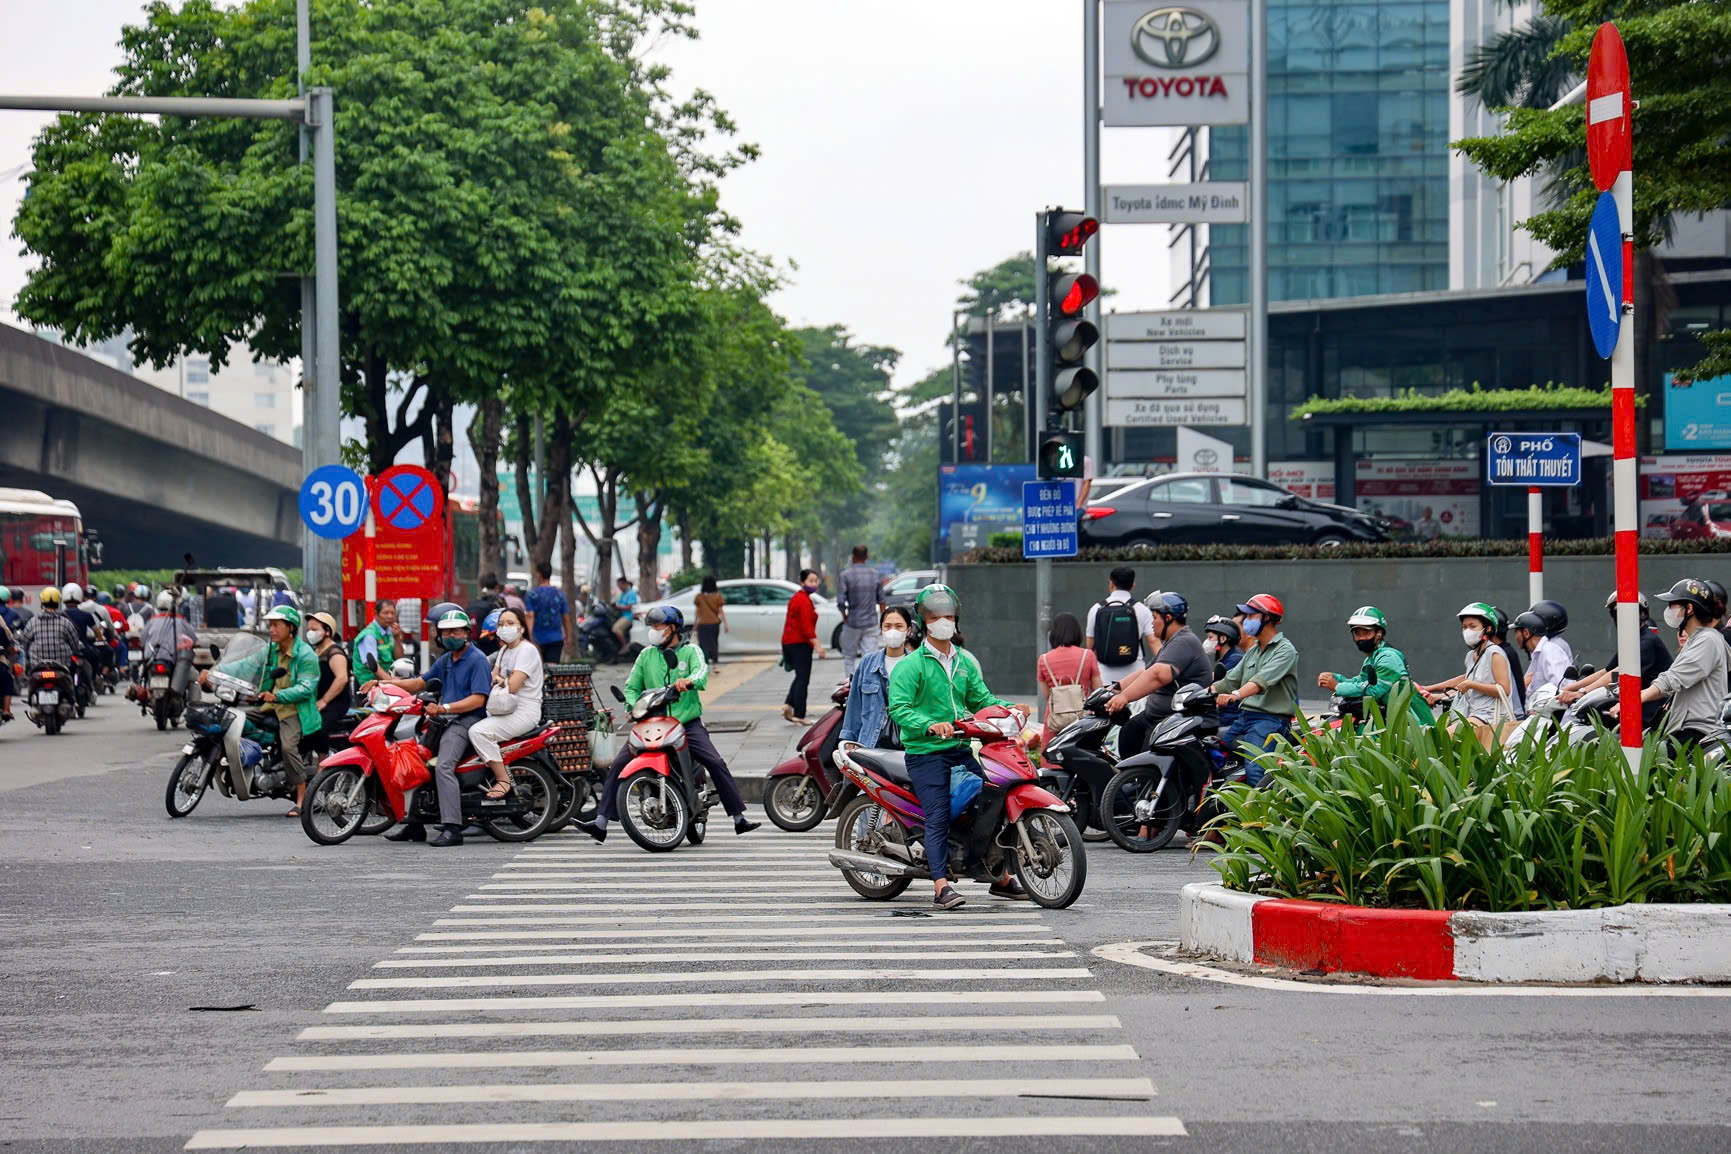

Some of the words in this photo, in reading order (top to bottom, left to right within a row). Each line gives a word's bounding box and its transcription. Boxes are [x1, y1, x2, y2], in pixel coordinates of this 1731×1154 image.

[1123, 76, 1228, 98] TOYOTA
[1111, 196, 1152, 213] Toyota
[1520, 437, 1554, 452] PHỐ
[1496, 455, 1514, 477] TÔN
[1516, 453, 1538, 477] THẤT
[1539, 453, 1573, 477] THUYẾT
[309, 481, 359, 525] 30
